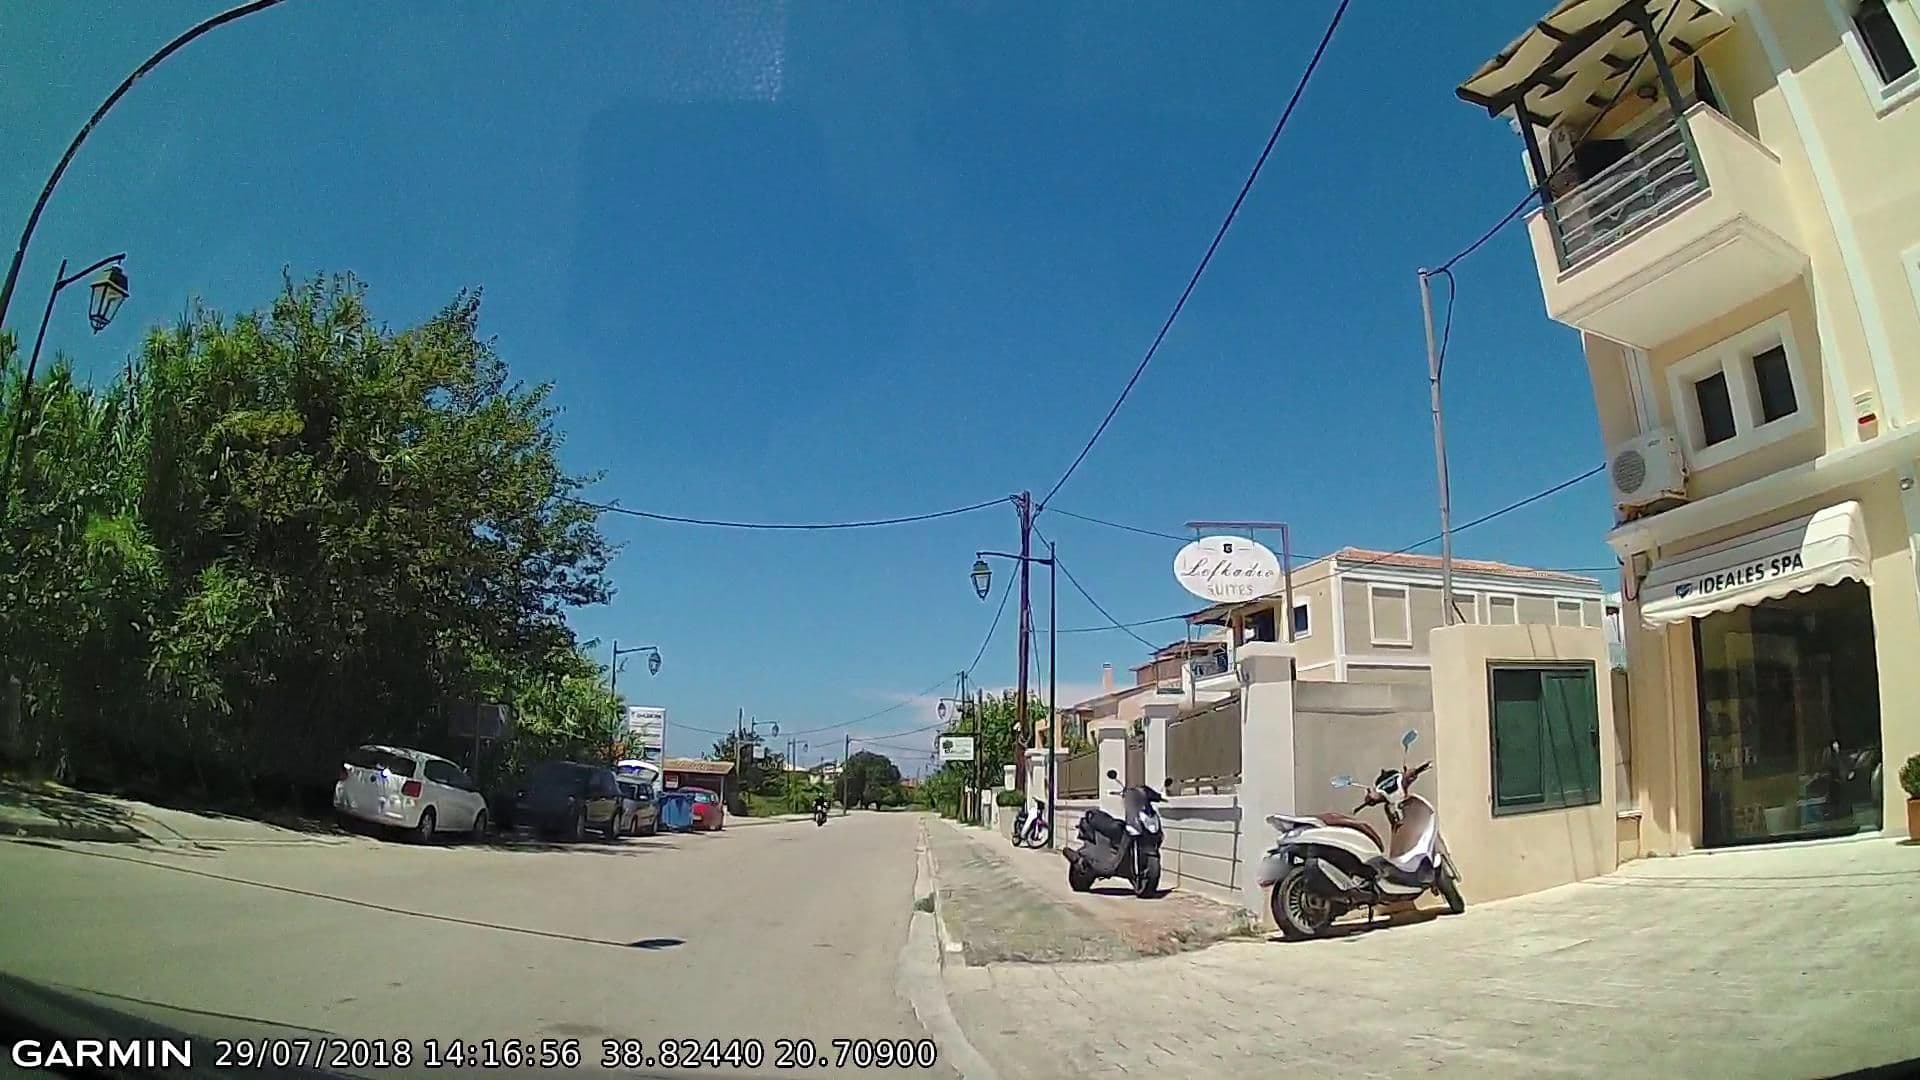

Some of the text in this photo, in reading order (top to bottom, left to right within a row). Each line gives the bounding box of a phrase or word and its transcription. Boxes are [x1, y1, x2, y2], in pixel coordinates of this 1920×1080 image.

[1698, 553, 1804, 595] IDEALES SPA
[1207, 583, 1255, 597] SUITES
